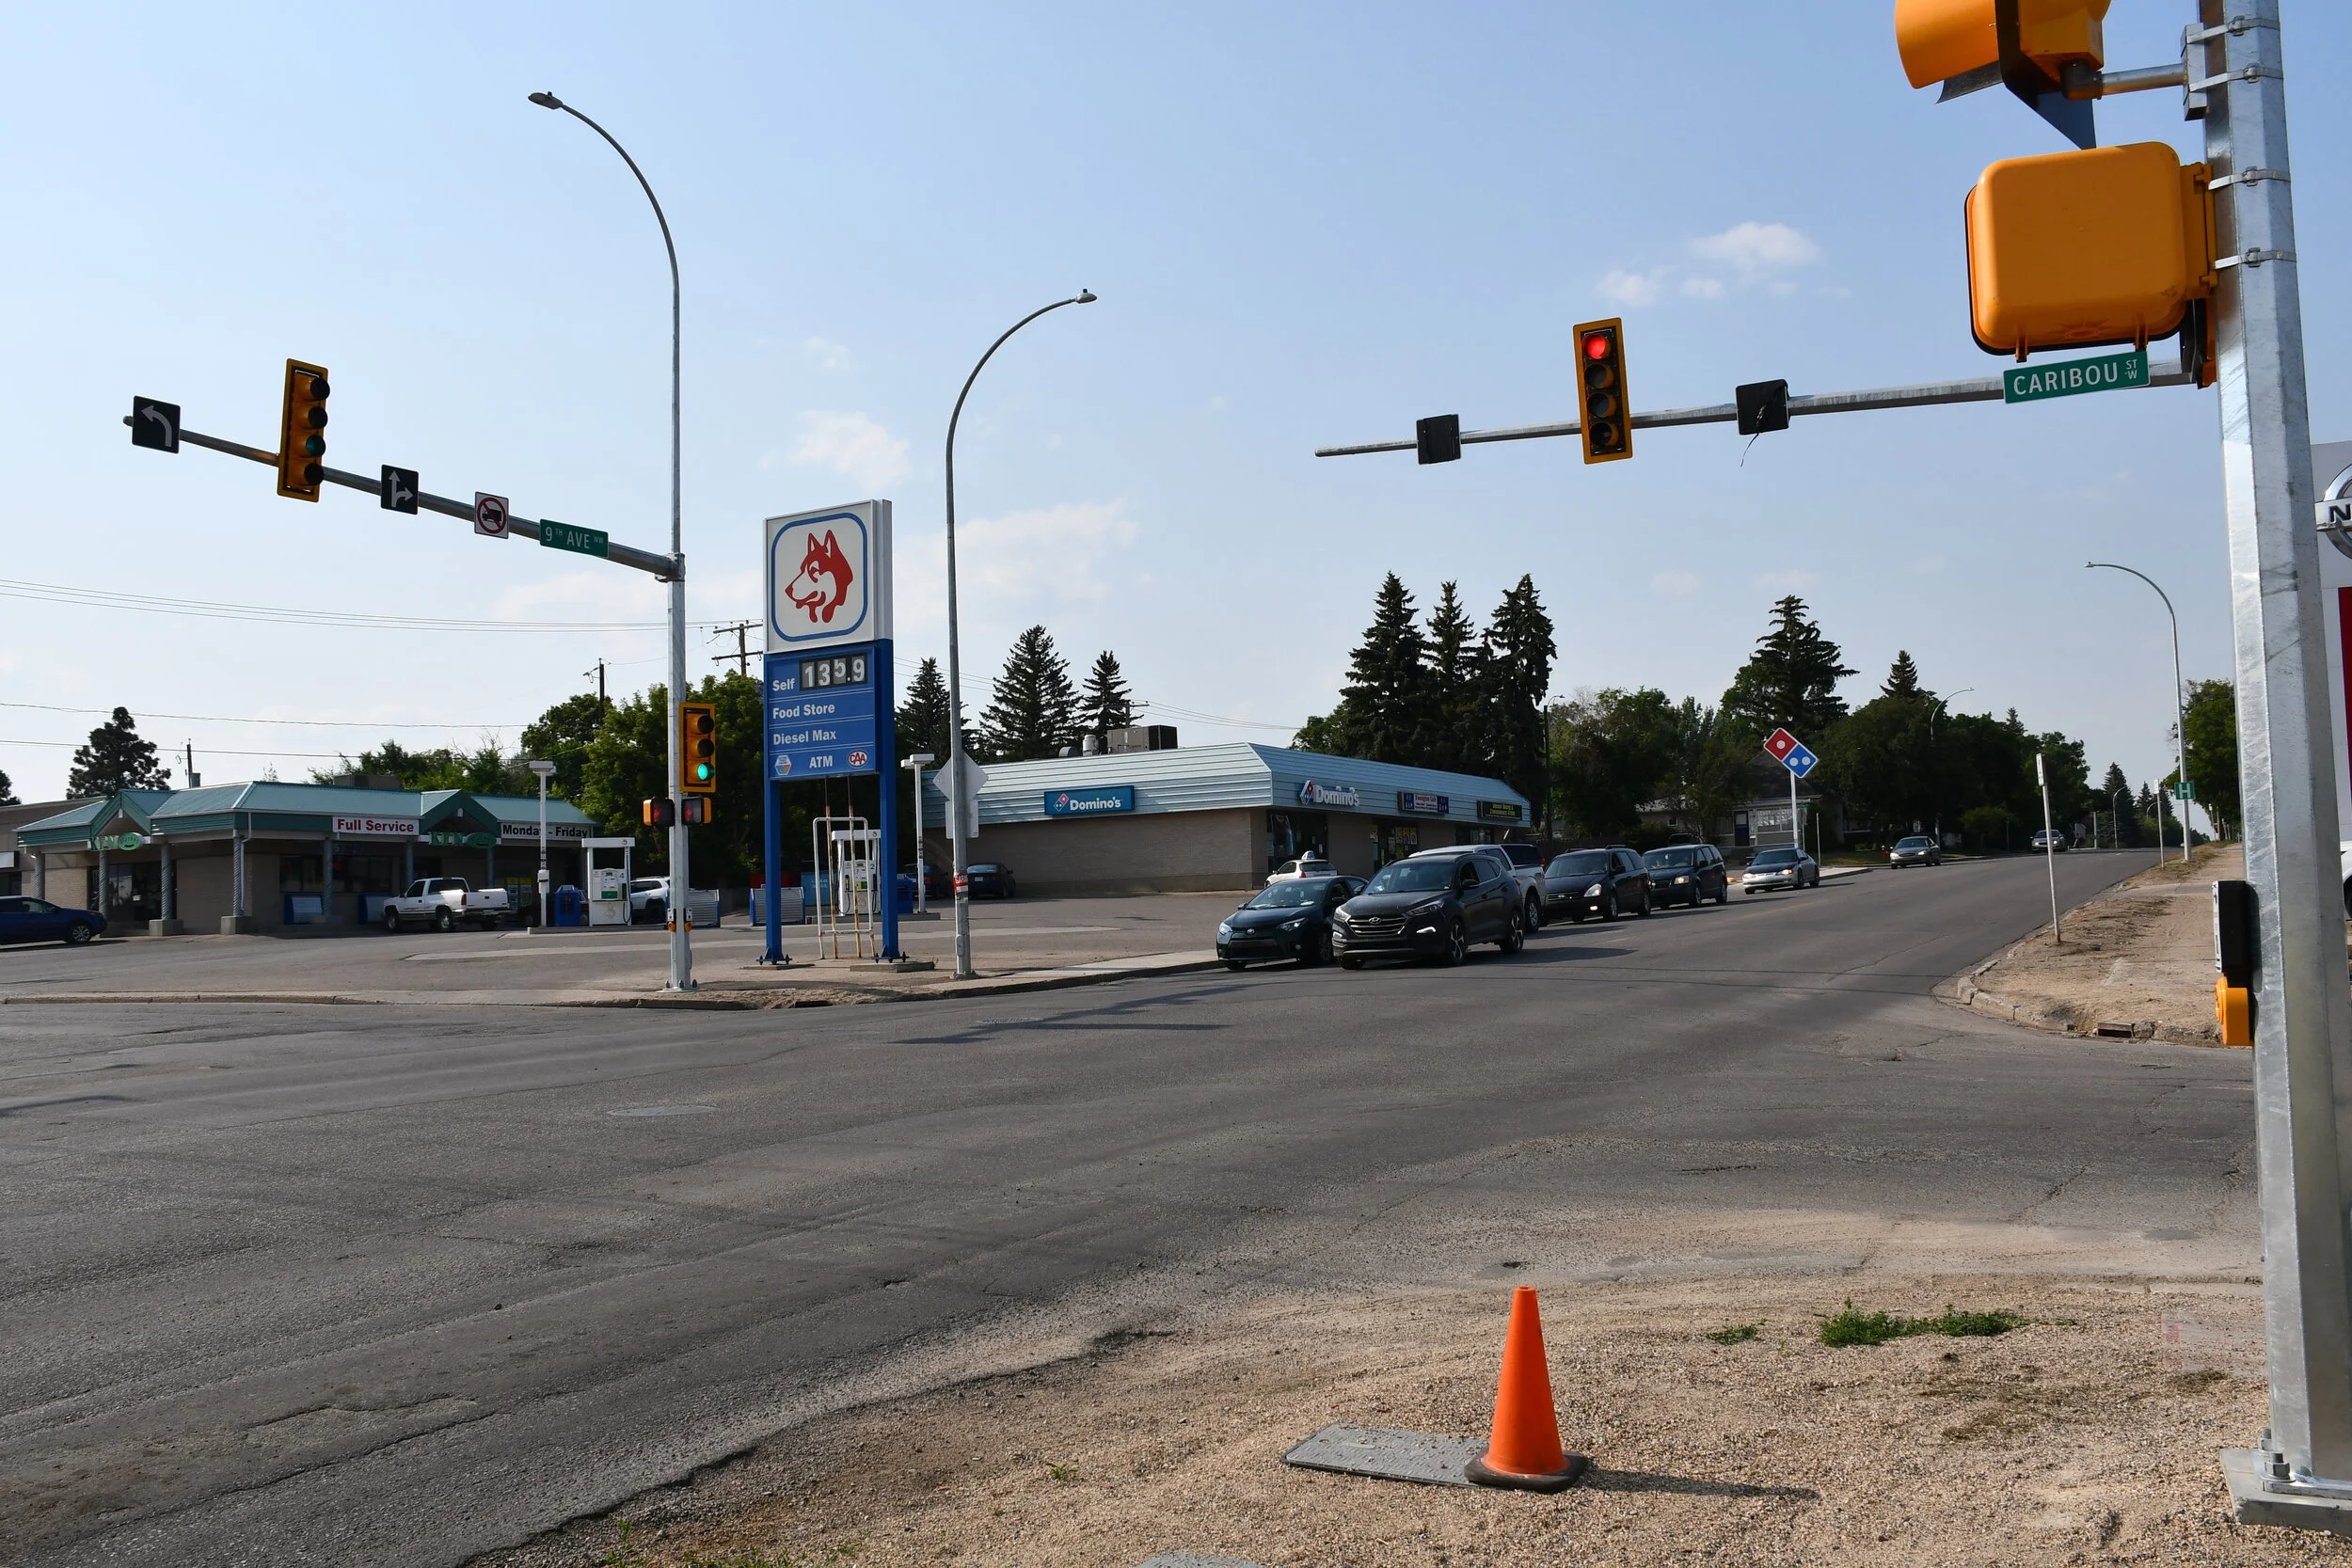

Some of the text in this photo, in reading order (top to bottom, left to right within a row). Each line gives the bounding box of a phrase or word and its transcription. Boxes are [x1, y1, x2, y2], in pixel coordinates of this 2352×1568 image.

[2013, 359, 2137, 395] CARIBOU ST
[2127, 370, 2137, 380] W
[566, 531, 591, 549] AVE
[772, 678, 796, 691] Self
[772, 704, 835, 720] Food Store
[773, 729, 836, 745] Diesel Max
[809, 752, 866, 768] ATM CAA
[1312, 784, 1360, 806] Domino's
[2178, 783, 2191, 799] H
[1070, 797, 1121, 811] Domino's
[337, 818, 415, 832] Full Service
[502, 825, 543, 836] Monda
[555, 827, 588, 839] Friday
